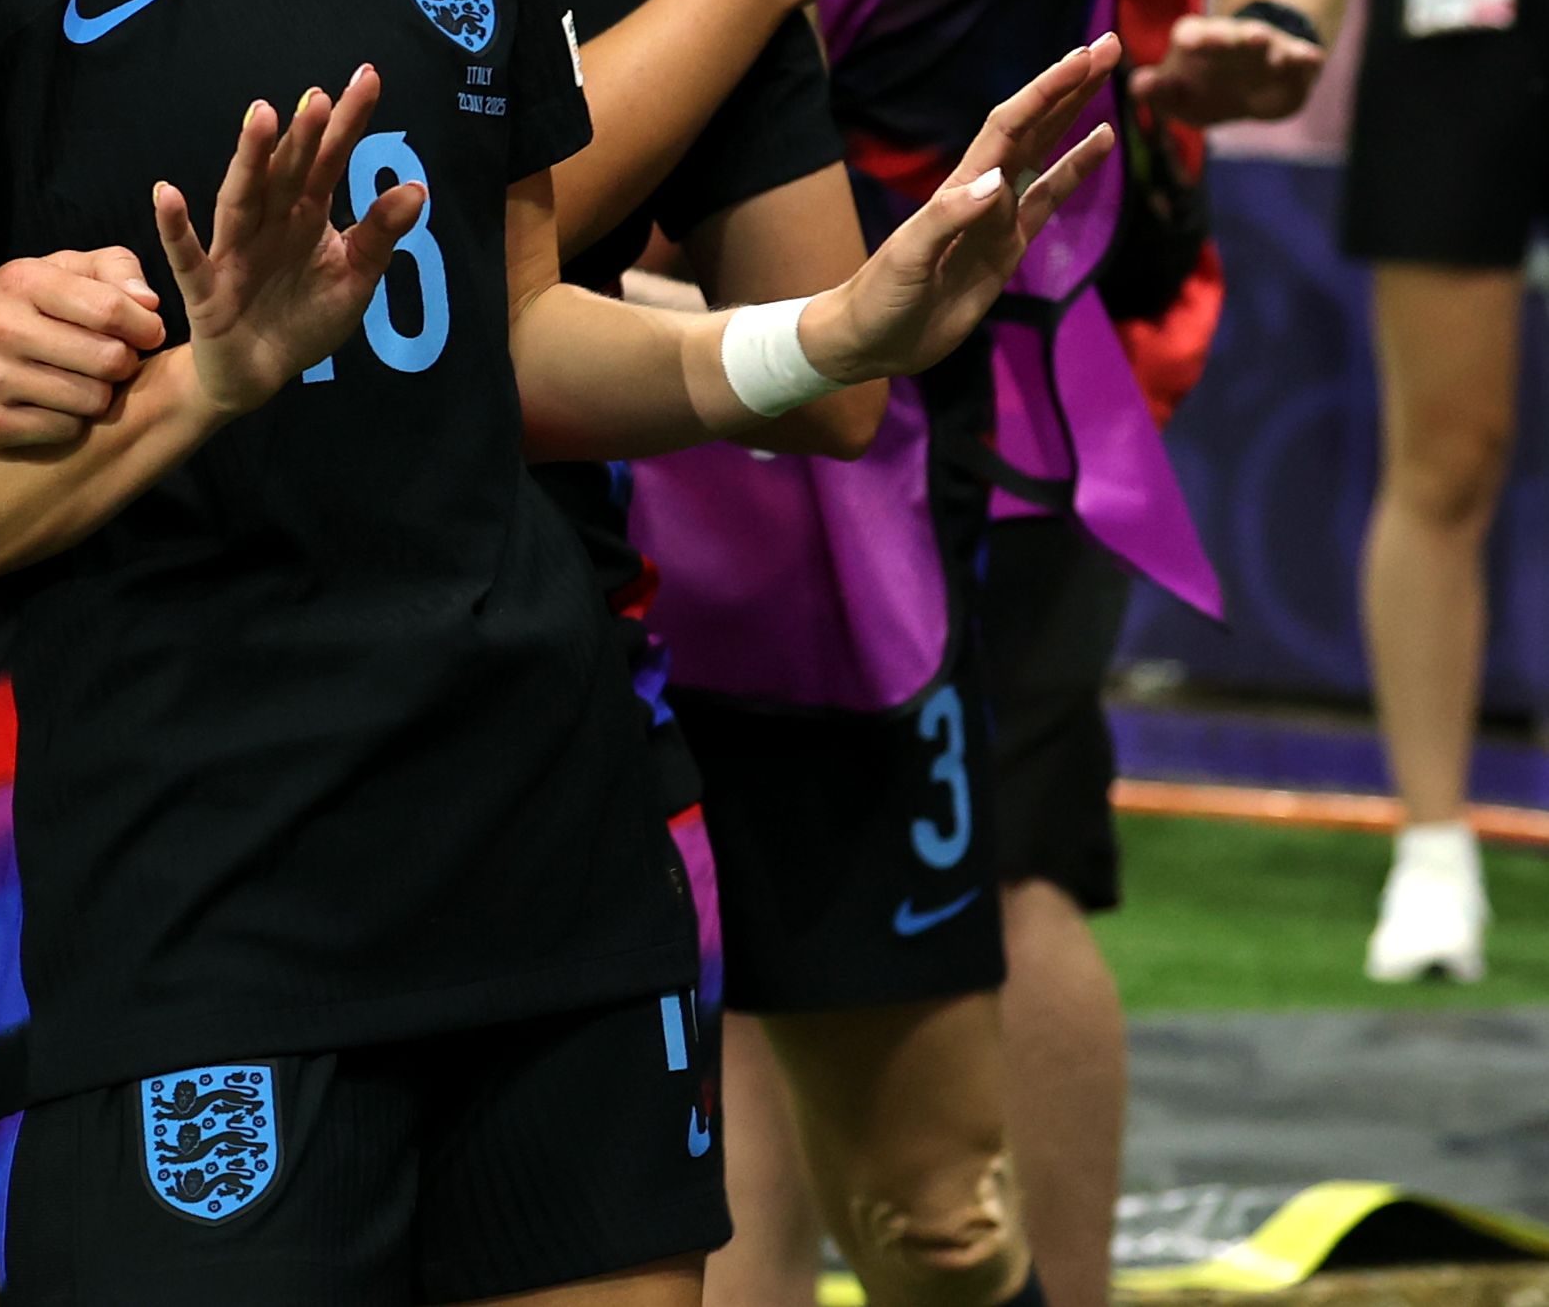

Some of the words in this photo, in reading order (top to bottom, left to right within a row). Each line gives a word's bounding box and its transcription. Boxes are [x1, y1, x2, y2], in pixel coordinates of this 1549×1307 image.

[466, 65, 493, 86] ITALY
[301, 130, 451, 384] 8
[911, 684, 973, 869] 3
